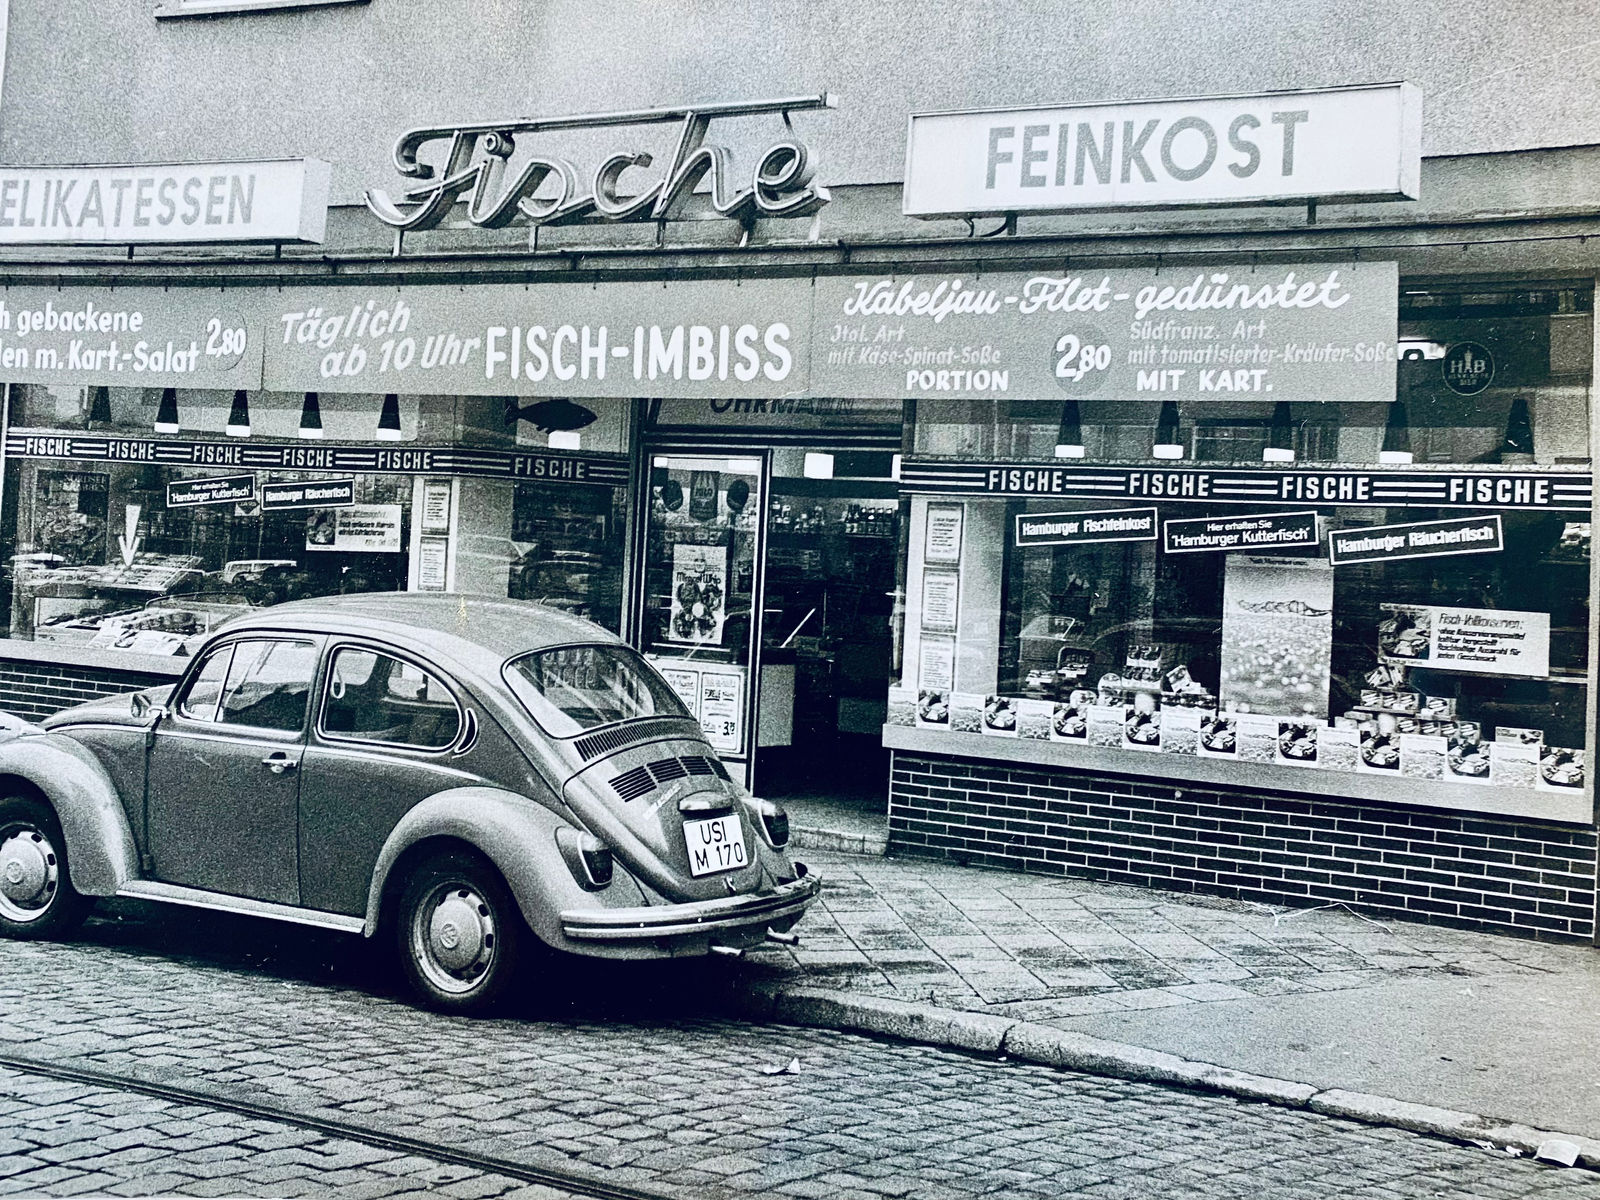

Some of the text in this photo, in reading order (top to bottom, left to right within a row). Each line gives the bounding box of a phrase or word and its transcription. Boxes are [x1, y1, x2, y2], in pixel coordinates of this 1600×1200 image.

[985, 109, 1309, 190] FEINKOST
[363, 94, 838, 230] Fische
[0, 174, 256, 228] ELIKATESSEN
[17, 302, 144, 337] gebackene
[280, 300, 412, 348] Täglich
[1130, 319, 1267, 341] Südfranz. Art
[206, 318, 248, 358] 2,80
[873, 324, 906, 343] Art
[35, 346, 63, 370] m.
[68, 339, 200, 373] Kart.-Salat
[320, 333, 480, 379] ab 10 Uhr
[484, 323, 793, 382] FISCH-IMBISS
[827, 346, 853, 365] mit
[1055, 334, 1112, 382] 2,80
[1128, 346, 1156, 365] mit
[906, 369, 1009, 392] PORTION
[1137, 369, 1273, 392] MIT KART.
[25, 438, 71, 456] FISCHE
[108, 441, 155, 460] FISCHE
[193, 445, 241, 464] FISCHE
[283, 449, 333, 467] FISCHE
[377, 451, 431, 470] FISCHE
[514, 457, 586, 479] FISCHE
[988, 470, 1063, 492] FISCHE
[1129, 473, 1209, 497] FISCHE
[1281, 476, 1370, 501] FISCHE
[1450, 478, 1549, 504] FISCHE
[265, 489, 303, 503] Hamburger
[1022, 517, 1152, 536] Hamburger Fischfeinkost
[1207, 519, 1273, 532] Hier erhalten Sie
[1337, 526, 1494, 553] Hamburger Räucherfisch
[700, 821, 729, 845] USI
[695, 842, 744, 871] M 170
